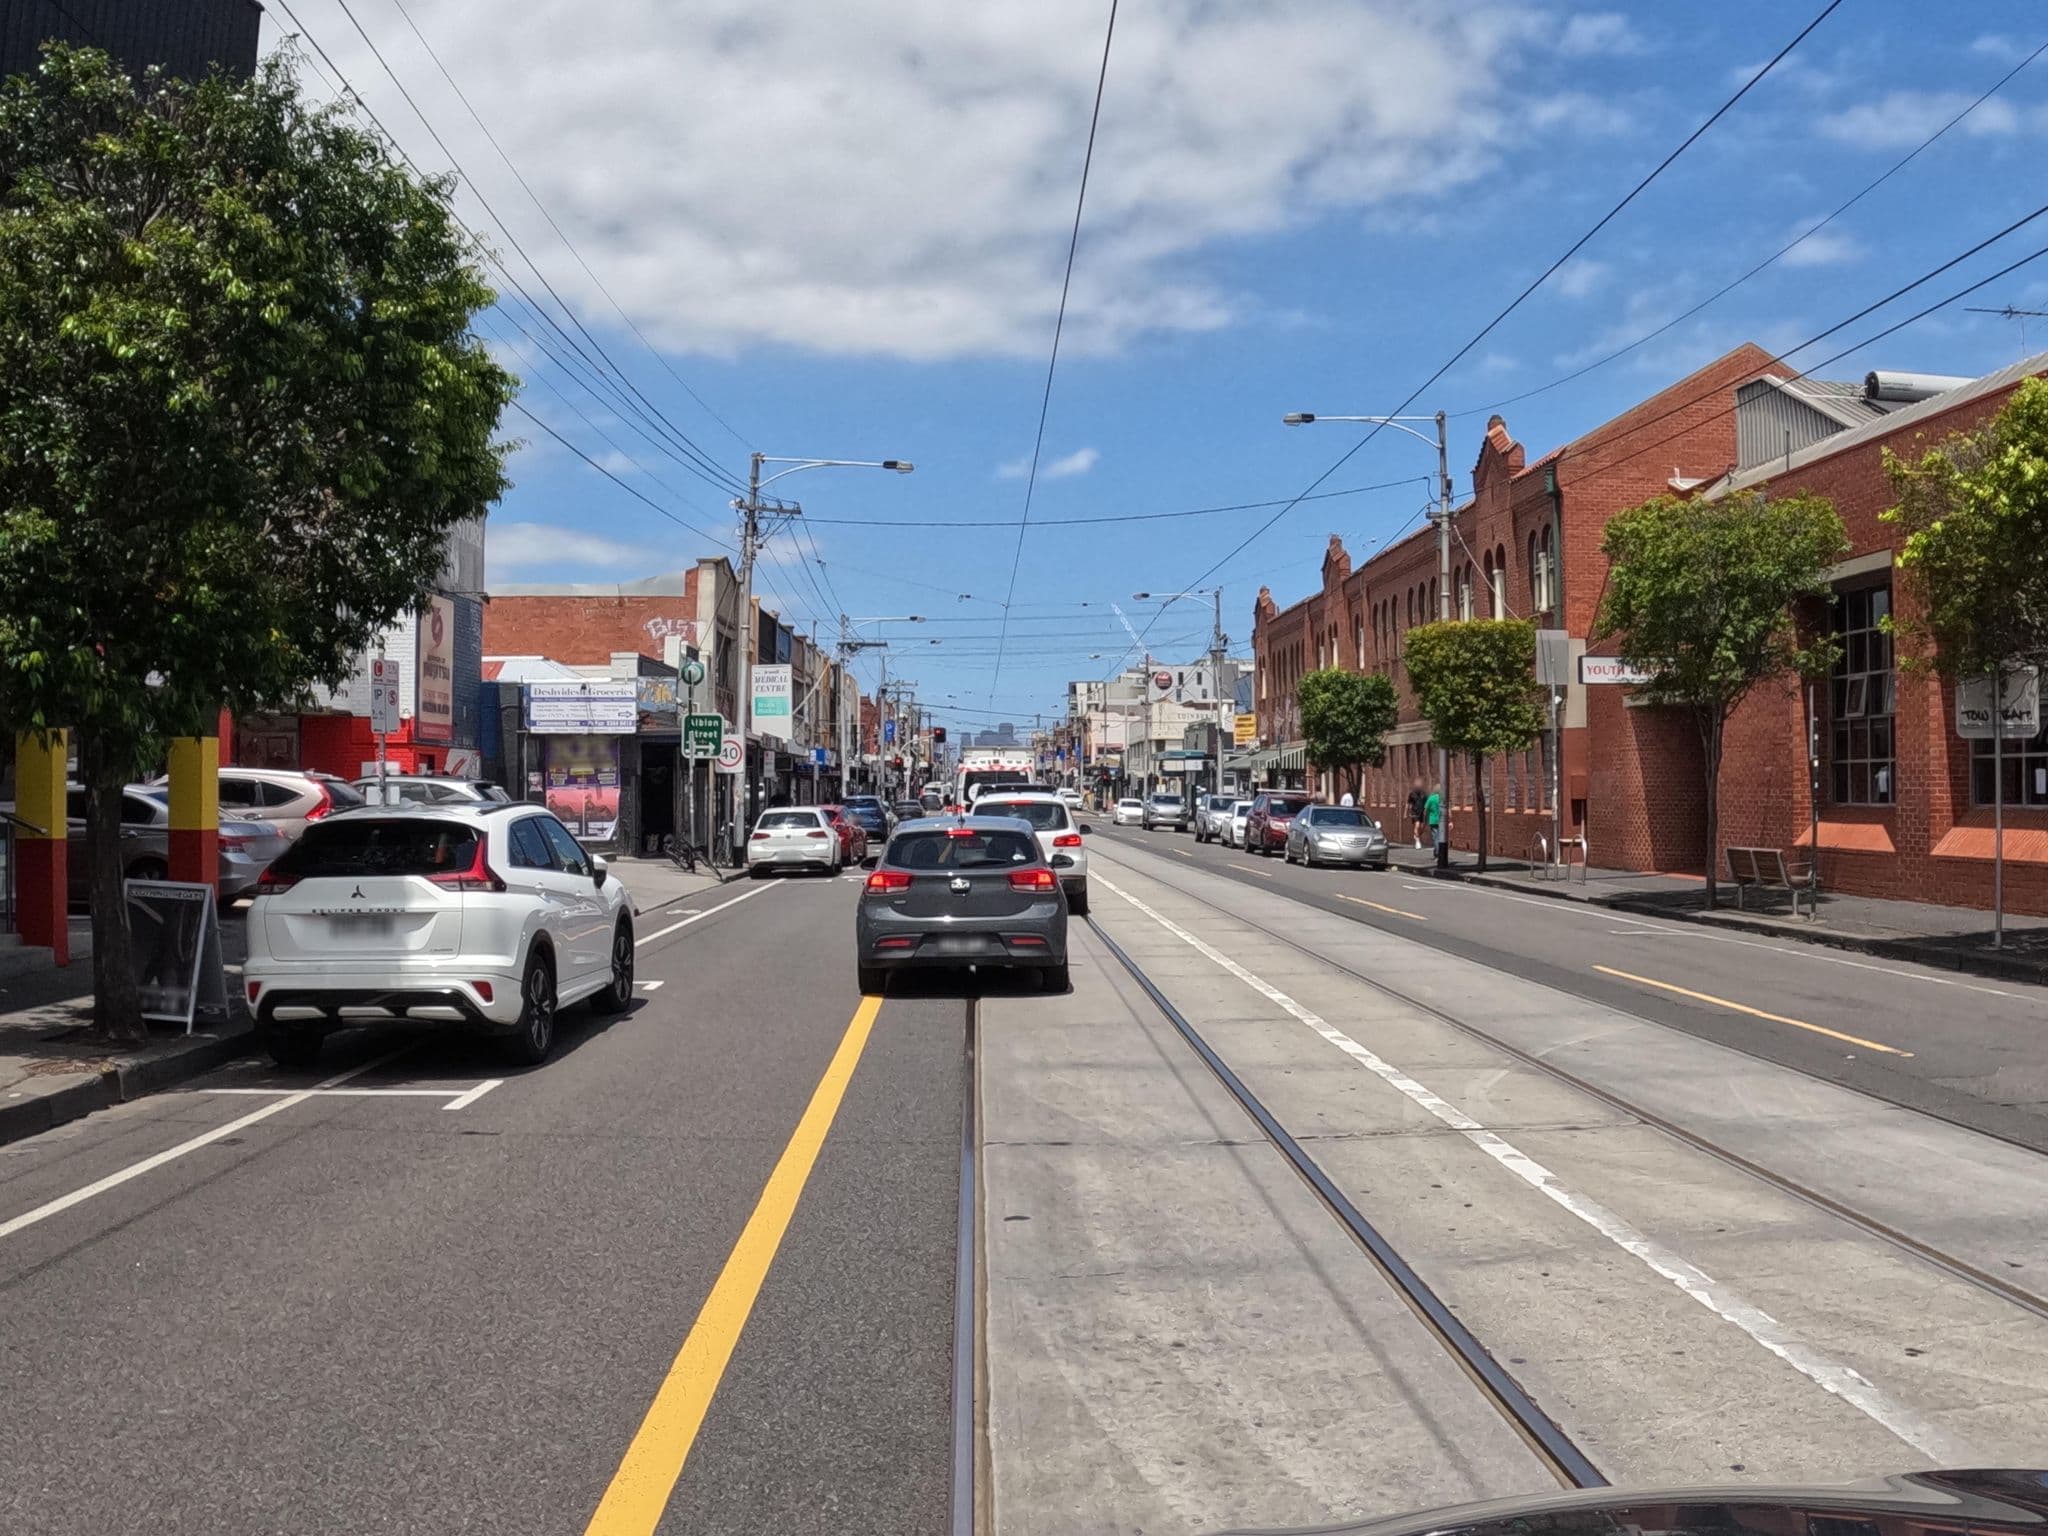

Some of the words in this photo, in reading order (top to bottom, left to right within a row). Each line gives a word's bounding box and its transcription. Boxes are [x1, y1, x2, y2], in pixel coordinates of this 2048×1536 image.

[754, 675, 788, 684] MEDICAL
[588, 687, 634, 696] Groceries
[755, 684, 786, 692] CENTRE
[720, 747, 738, 760] 40
